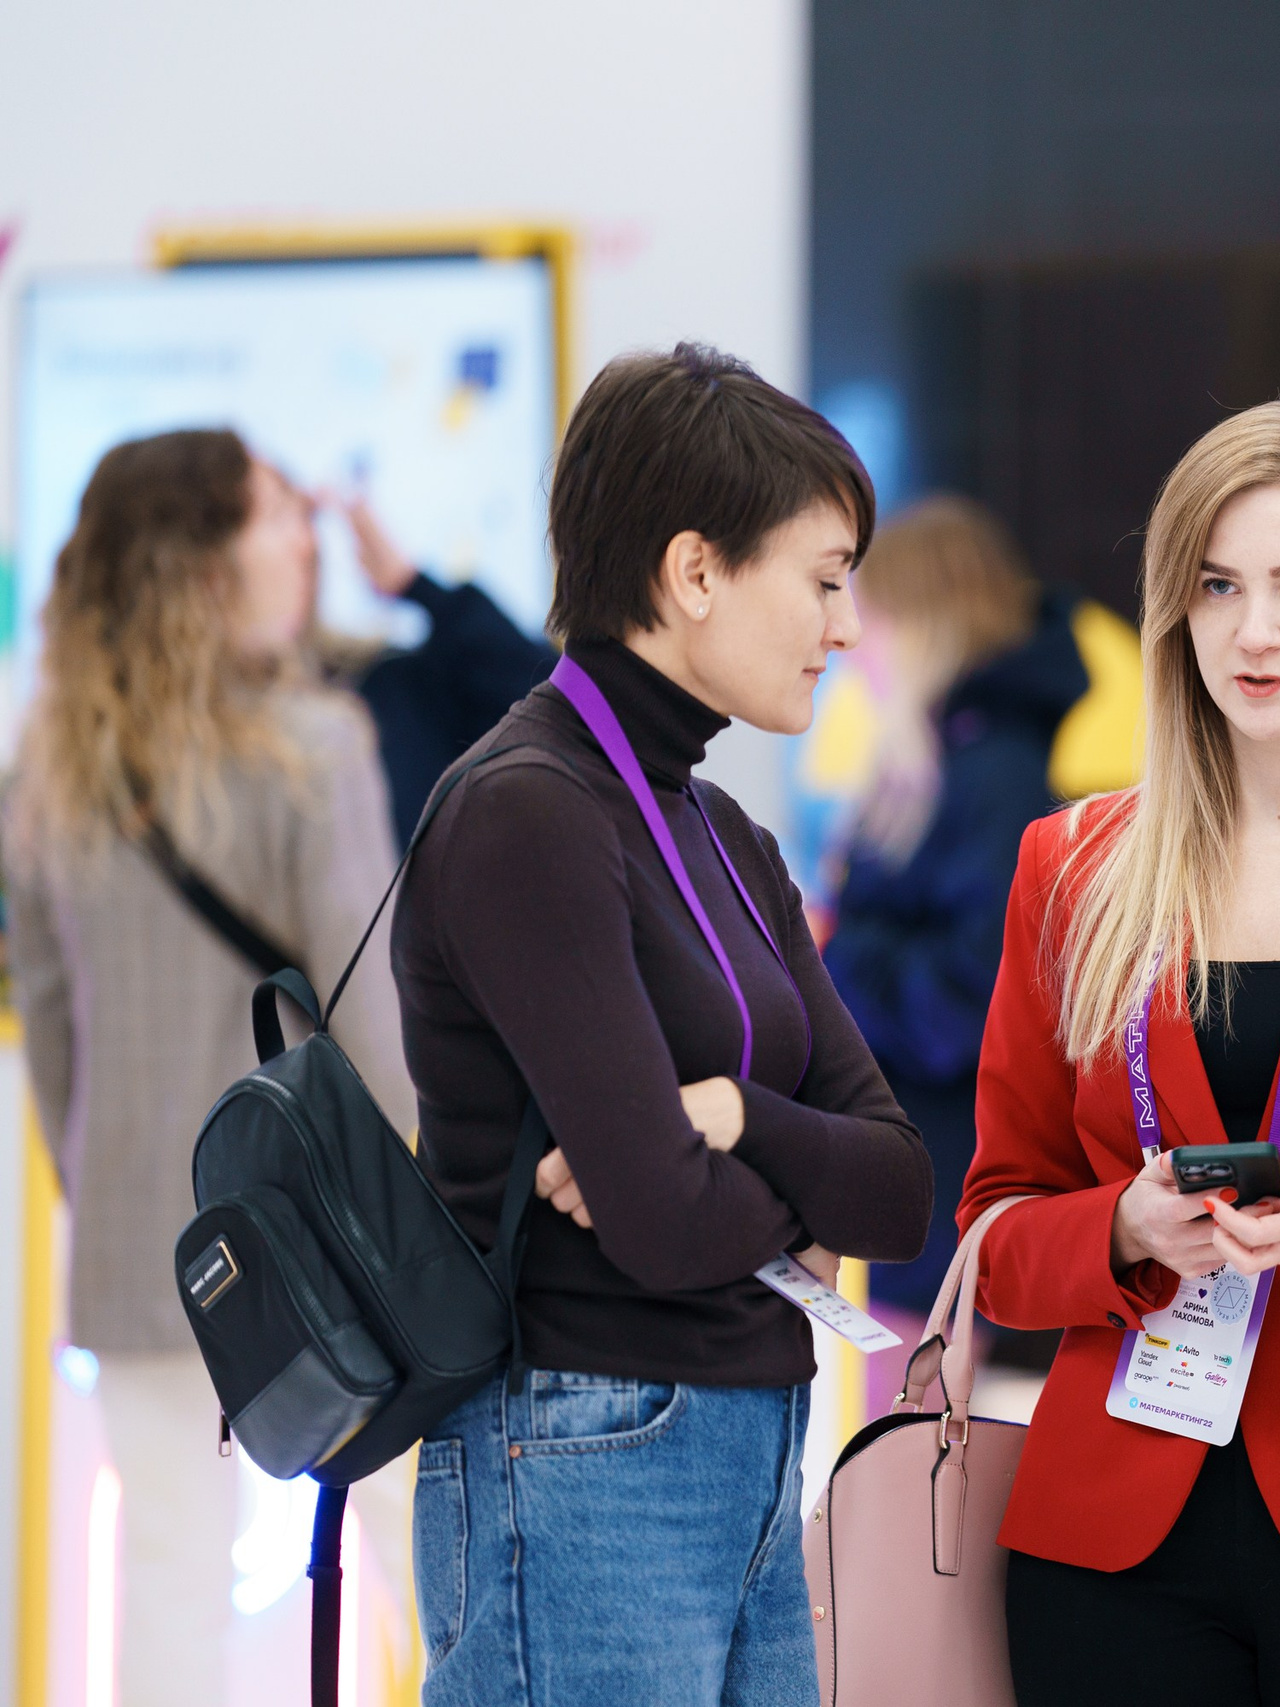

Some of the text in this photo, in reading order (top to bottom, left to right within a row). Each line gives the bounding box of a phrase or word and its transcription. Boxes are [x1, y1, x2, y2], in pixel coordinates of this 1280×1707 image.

[1182, 1301, 1209, 1315] АРИНА
[1171, 1309, 1214, 1328] ПАХОМОВА
[1140, 1350, 1159, 1361] Yandex
[1182, 1345, 1200, 1357] Avito
[1137, 1357, 1153, 1367] Cloud
[1139, 1401, 1214, 1428] МАТЕМАРКЕТИНГ22
